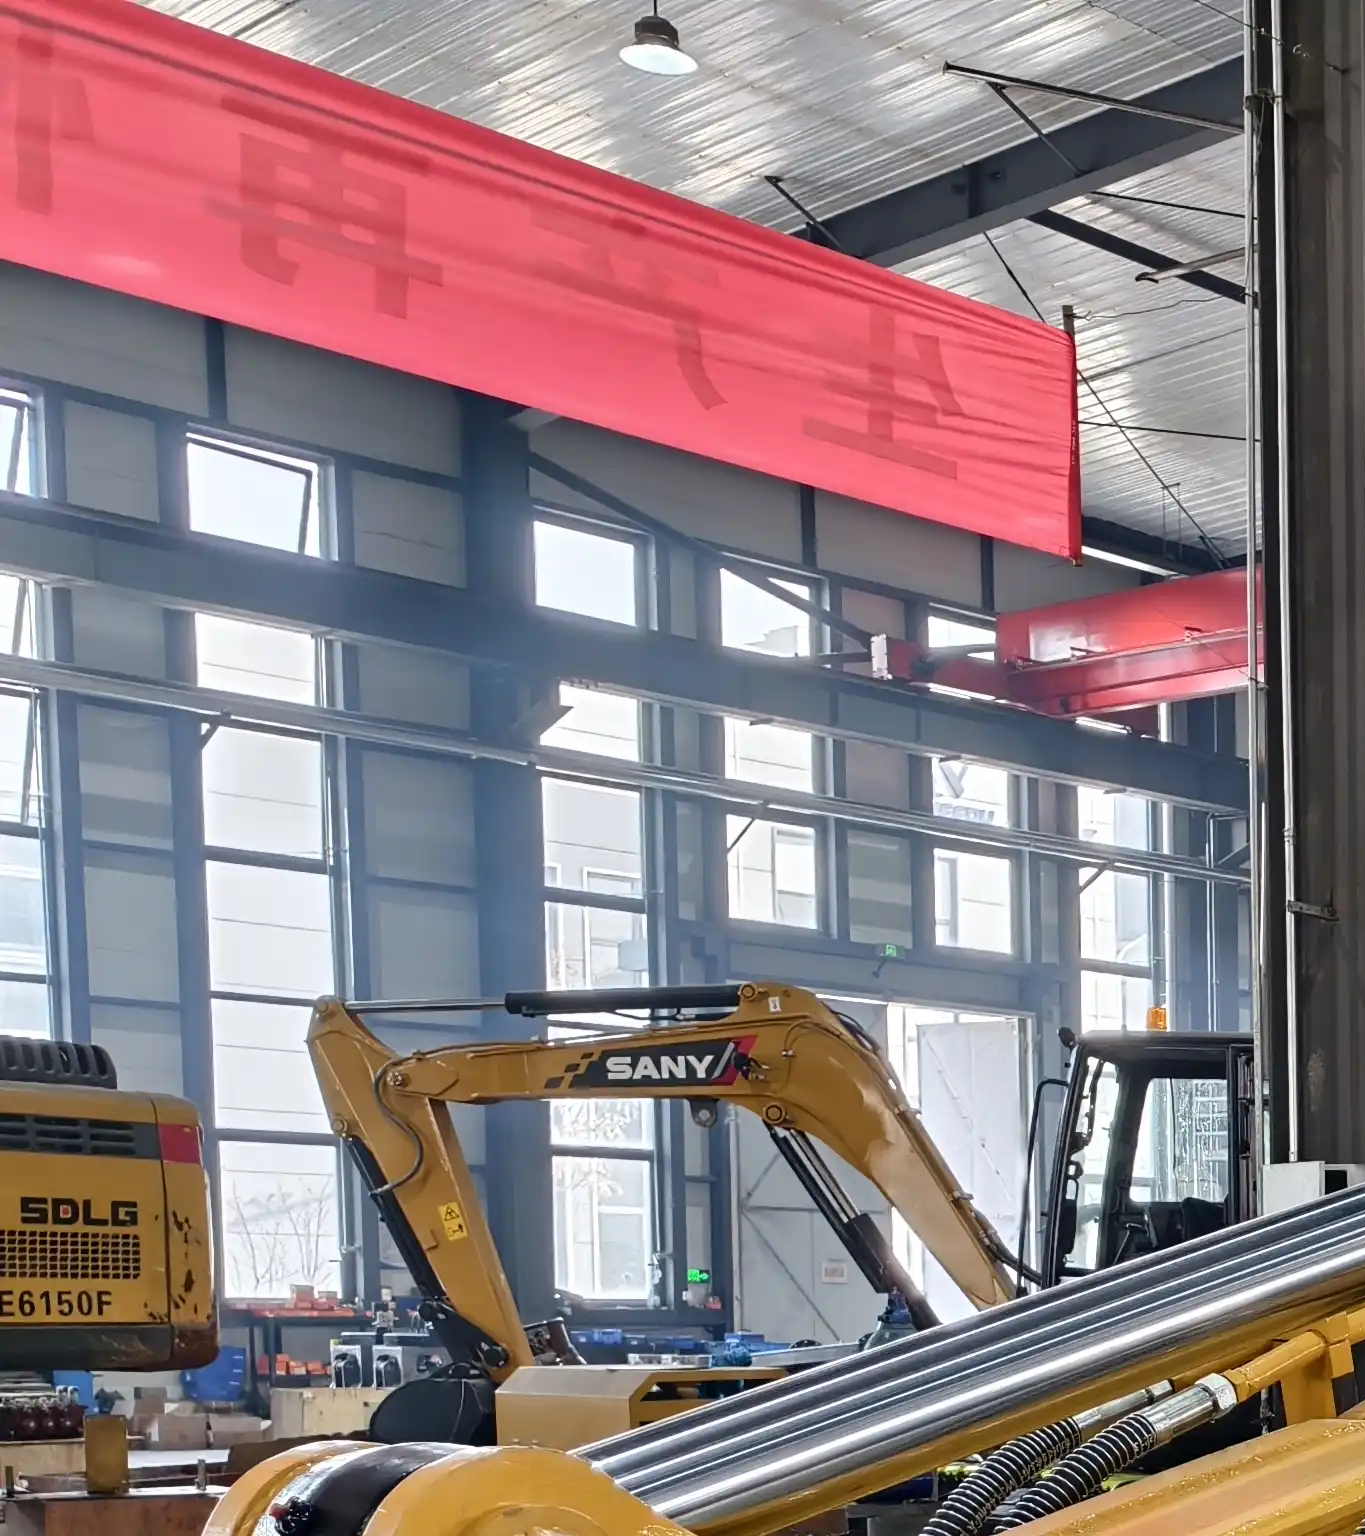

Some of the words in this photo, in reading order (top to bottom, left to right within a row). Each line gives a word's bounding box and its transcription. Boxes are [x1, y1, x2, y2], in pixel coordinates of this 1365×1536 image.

[605, 1055, 716, 1081] SANY
[20, 1197, 138, 1226] SDLG
[0, 1290, 113, 1317] E6150F
